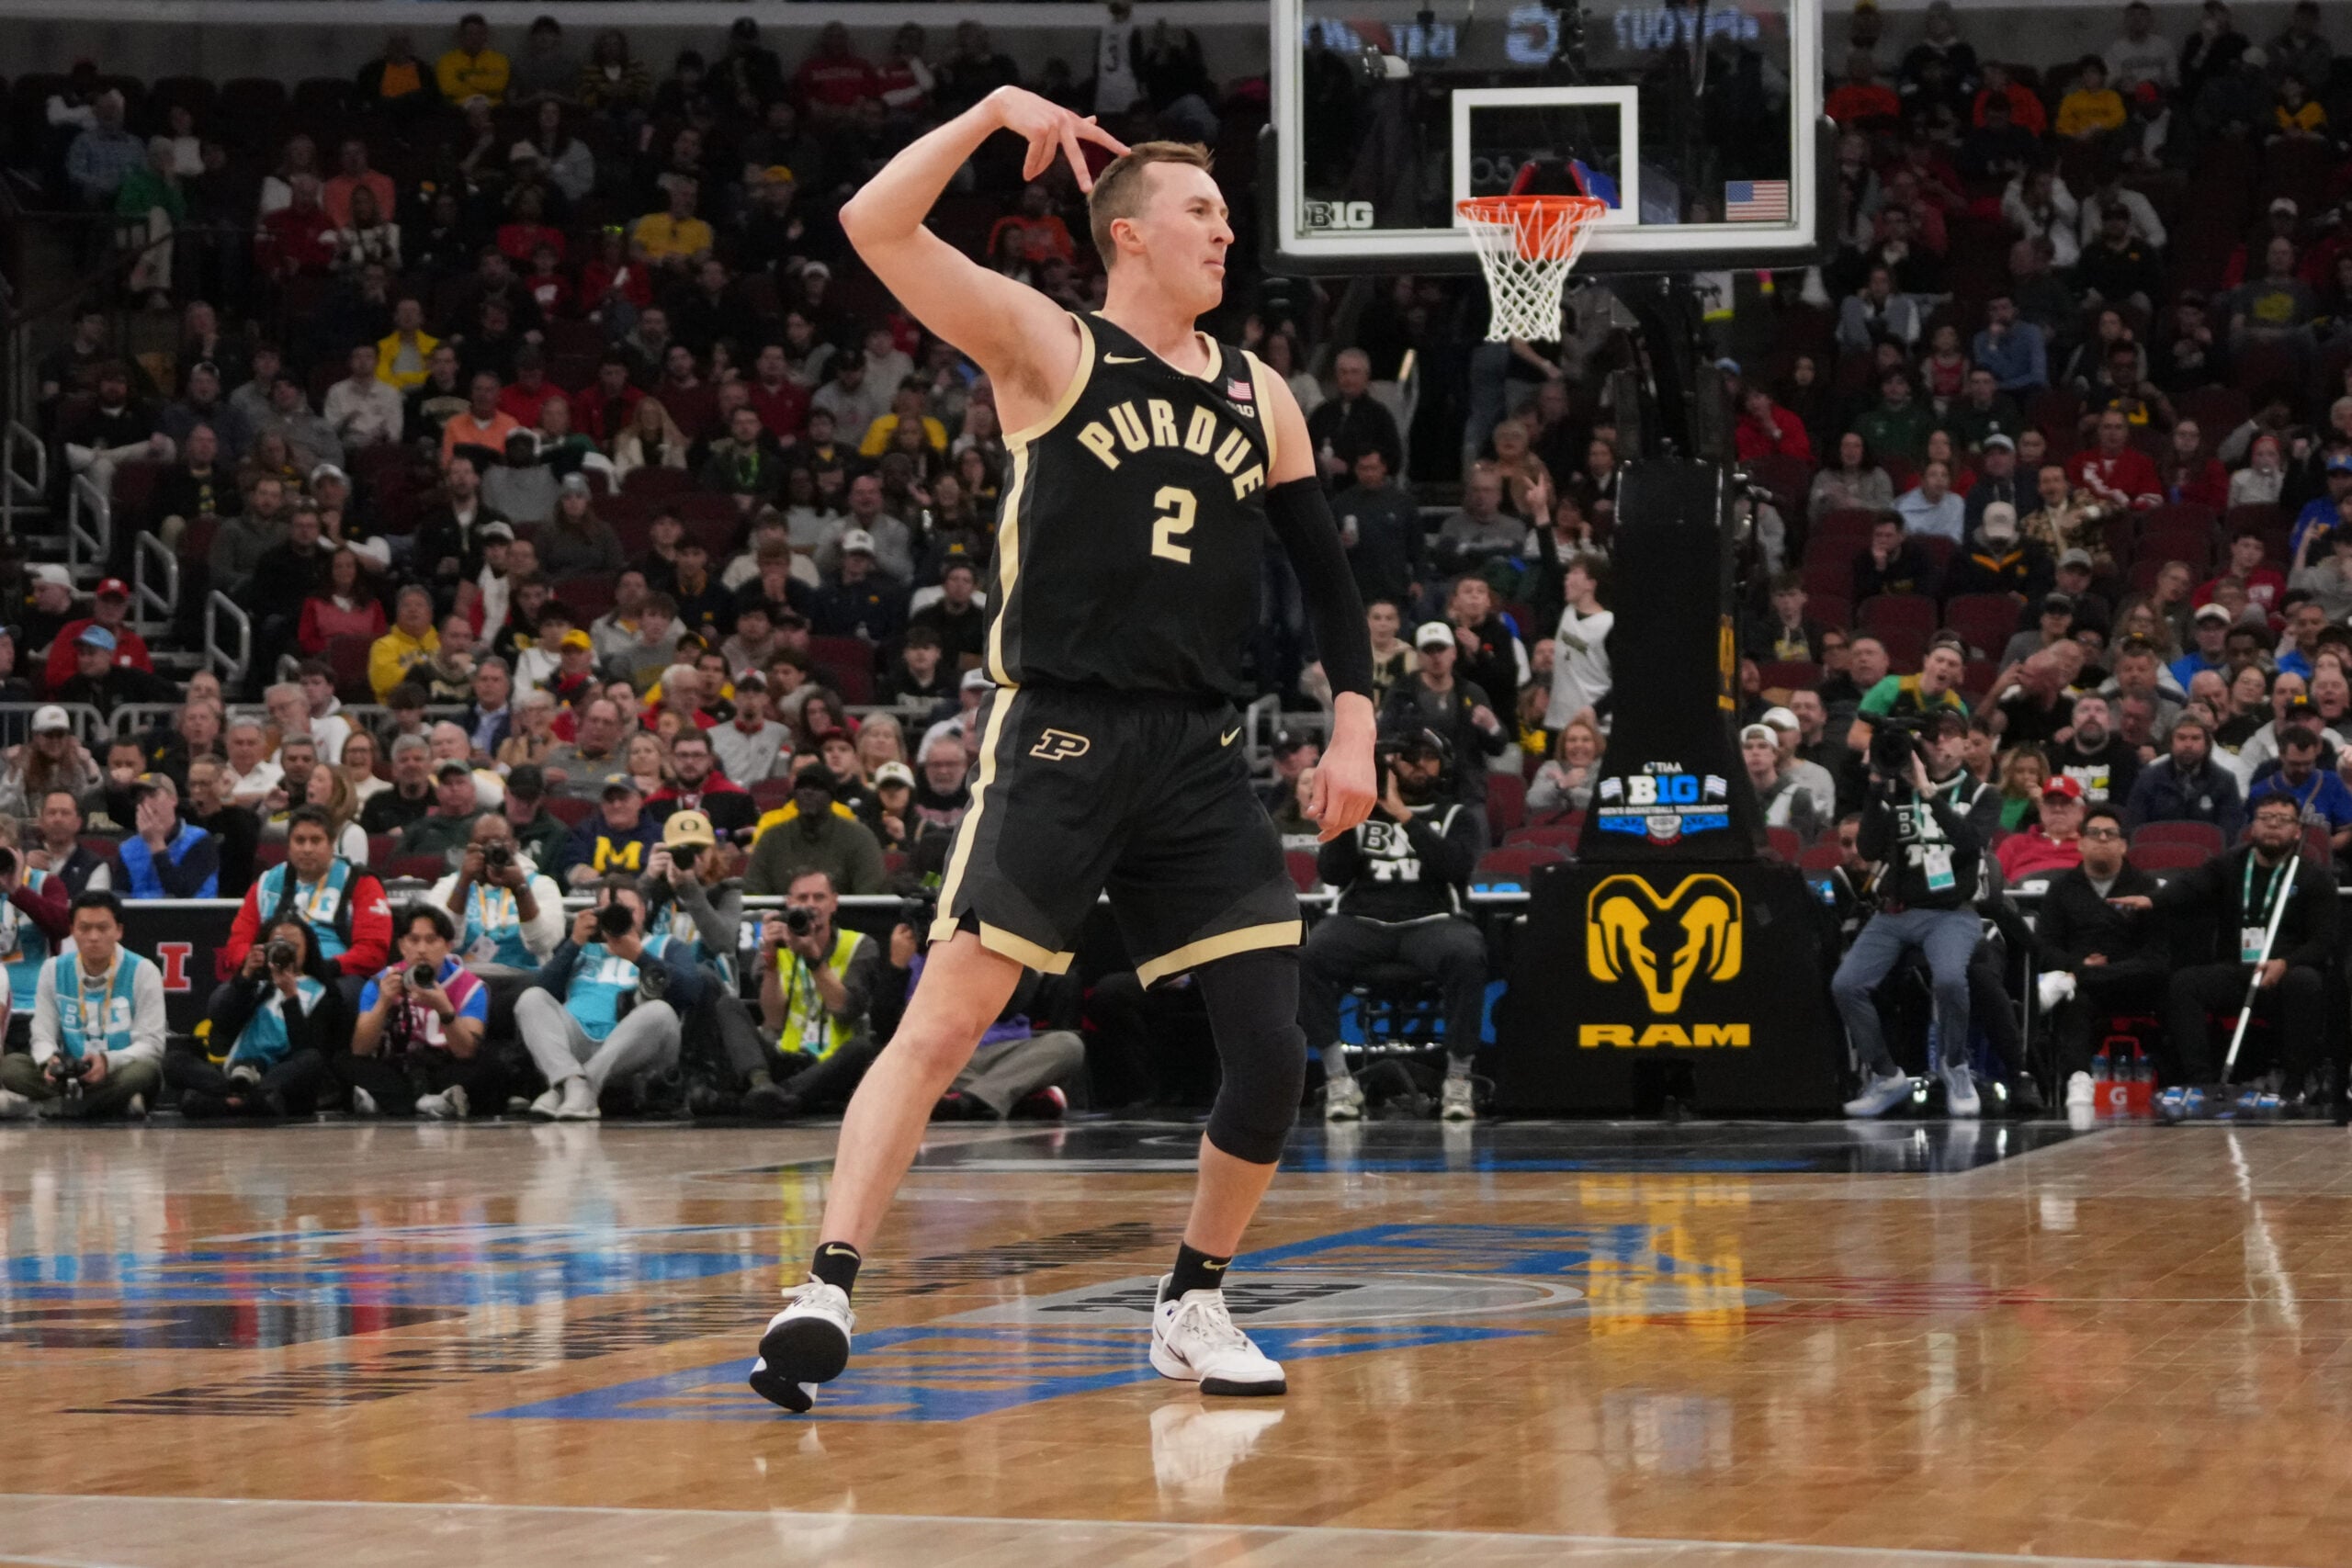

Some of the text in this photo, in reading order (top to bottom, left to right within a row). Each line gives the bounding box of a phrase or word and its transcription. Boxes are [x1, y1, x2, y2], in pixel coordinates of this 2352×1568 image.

[1078, 398, 1265, 502] PURDUE
[1150, 486, 1198, 565] 2
[1029, 728, 1091, 761] P
[1657, 762, 1683, 773] TIAA
[679, 818, 700, 832] O
[593, 836, 644, 873] M
[1370, 858, 1421, 882] TV
[1578, 1023, 1751, 1048] RAM
[2109, 1086, 2129, 1106] G
